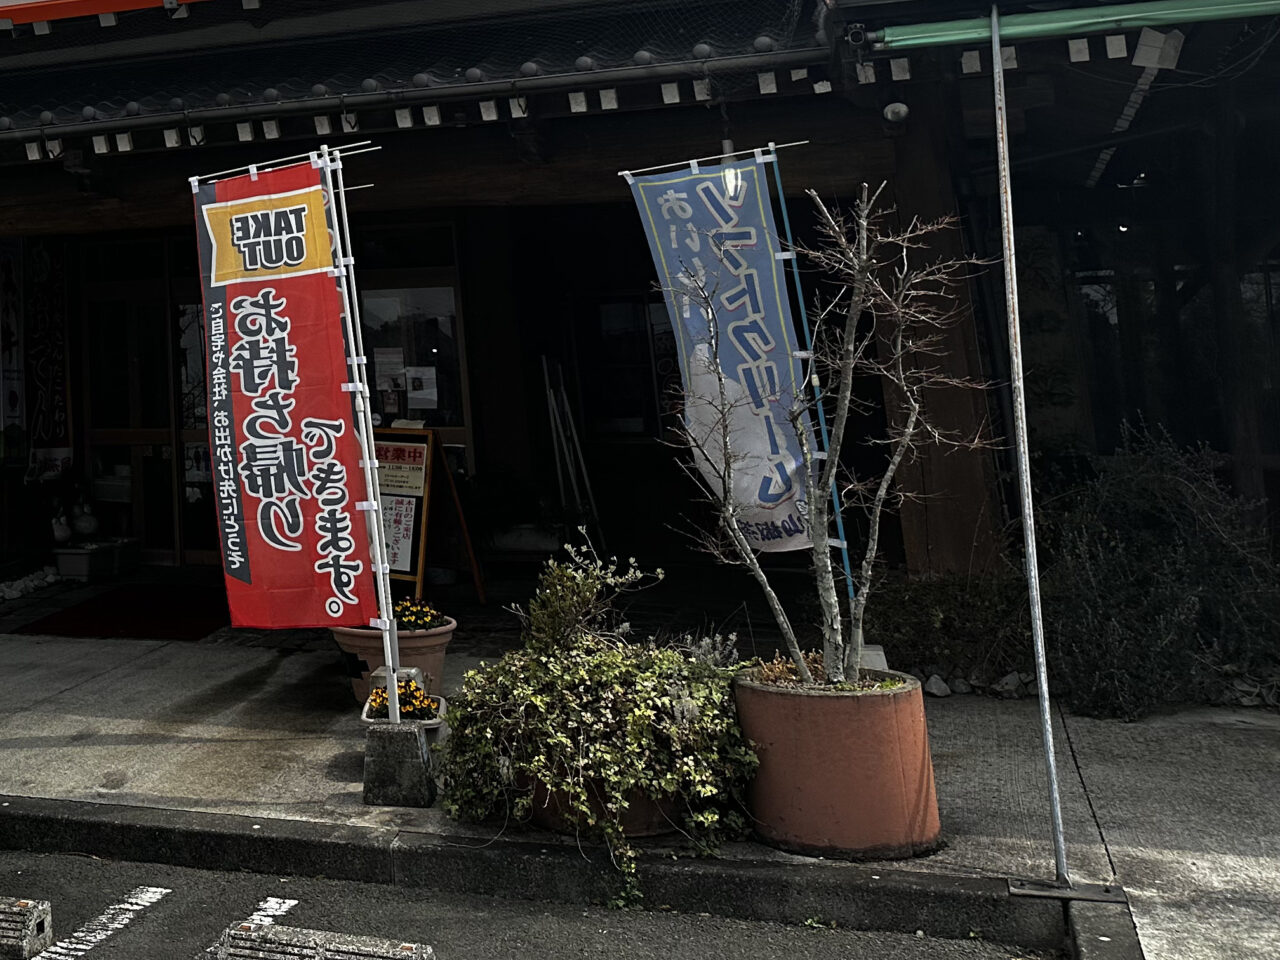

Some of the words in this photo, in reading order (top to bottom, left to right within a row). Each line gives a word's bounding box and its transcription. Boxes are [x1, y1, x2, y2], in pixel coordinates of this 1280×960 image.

[376, 447, 423, 462] 営業中
[402, 499, 414, 540] 本日のご来店
